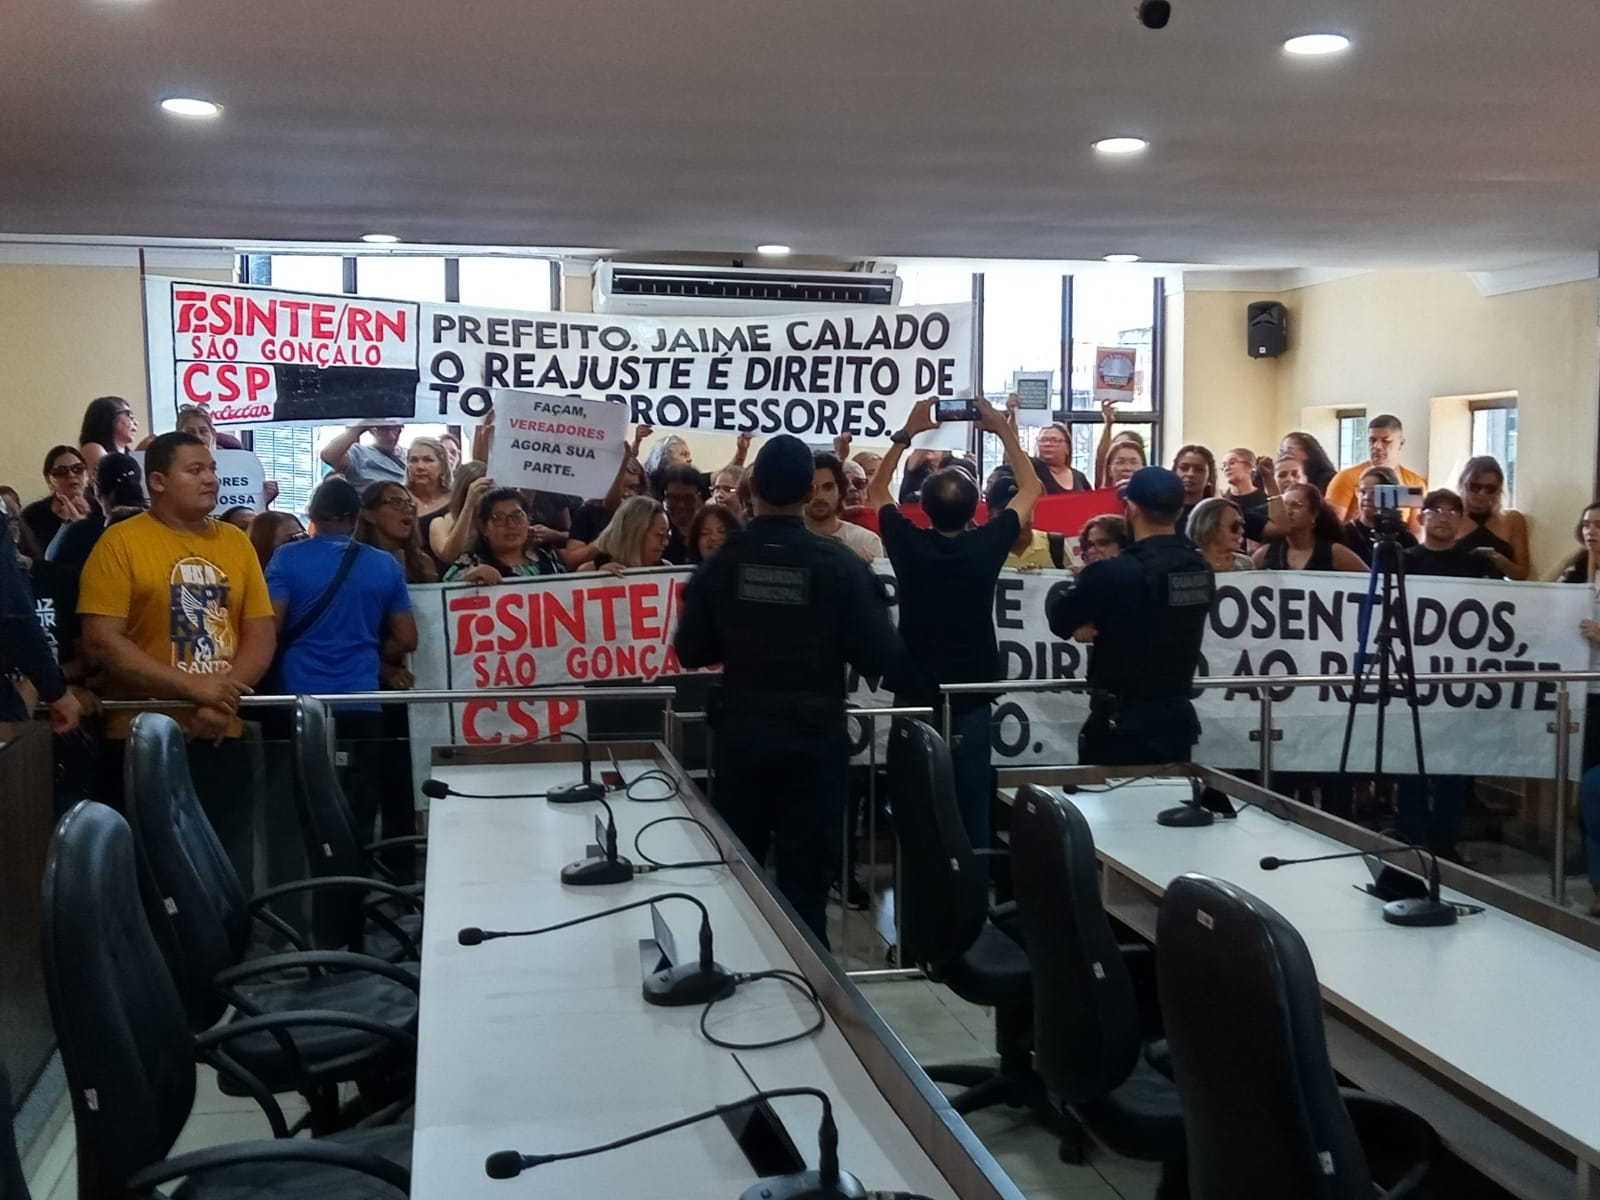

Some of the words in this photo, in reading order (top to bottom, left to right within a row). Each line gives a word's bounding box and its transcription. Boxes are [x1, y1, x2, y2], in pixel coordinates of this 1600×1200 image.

[209, 294, 406, 344] SINTE/RN
[433, 314, 638, 350] PREFEITO,
[651, 325, 771, 352] JAIME
[786, 312, 949, 350] CALADO
[191, 335, 239, 361] SÃO
[260, 338, 382, 367] GONÇALO
[183, 363, 271, 402] CSP
[431, 351, 464, 384] O
[484, 352, 694, 390] REAJUSTE
[708, 353, 733, 389] É
[744, 356, 899, 395] DIREITO
[915, 358, 955, 395] DE
[429, 383, 493, 417] TO
[533, 401, 587, 419] FAÇAM,
[509, 418, 605, 440] VEREADORES
[510, 439, 562, 454] AGORA
[566, 445, 596, 459] SUA
[219, 476, 249, 487] RES
[523, 460, 575, 477] PARTE.
[496, 577, 697, 651] SINTE/
[1209, 585, 1528, 658] OSENTADOS,
[473, 651, 537, 688] SÃO
[462, 697, 580, 745] CSP
